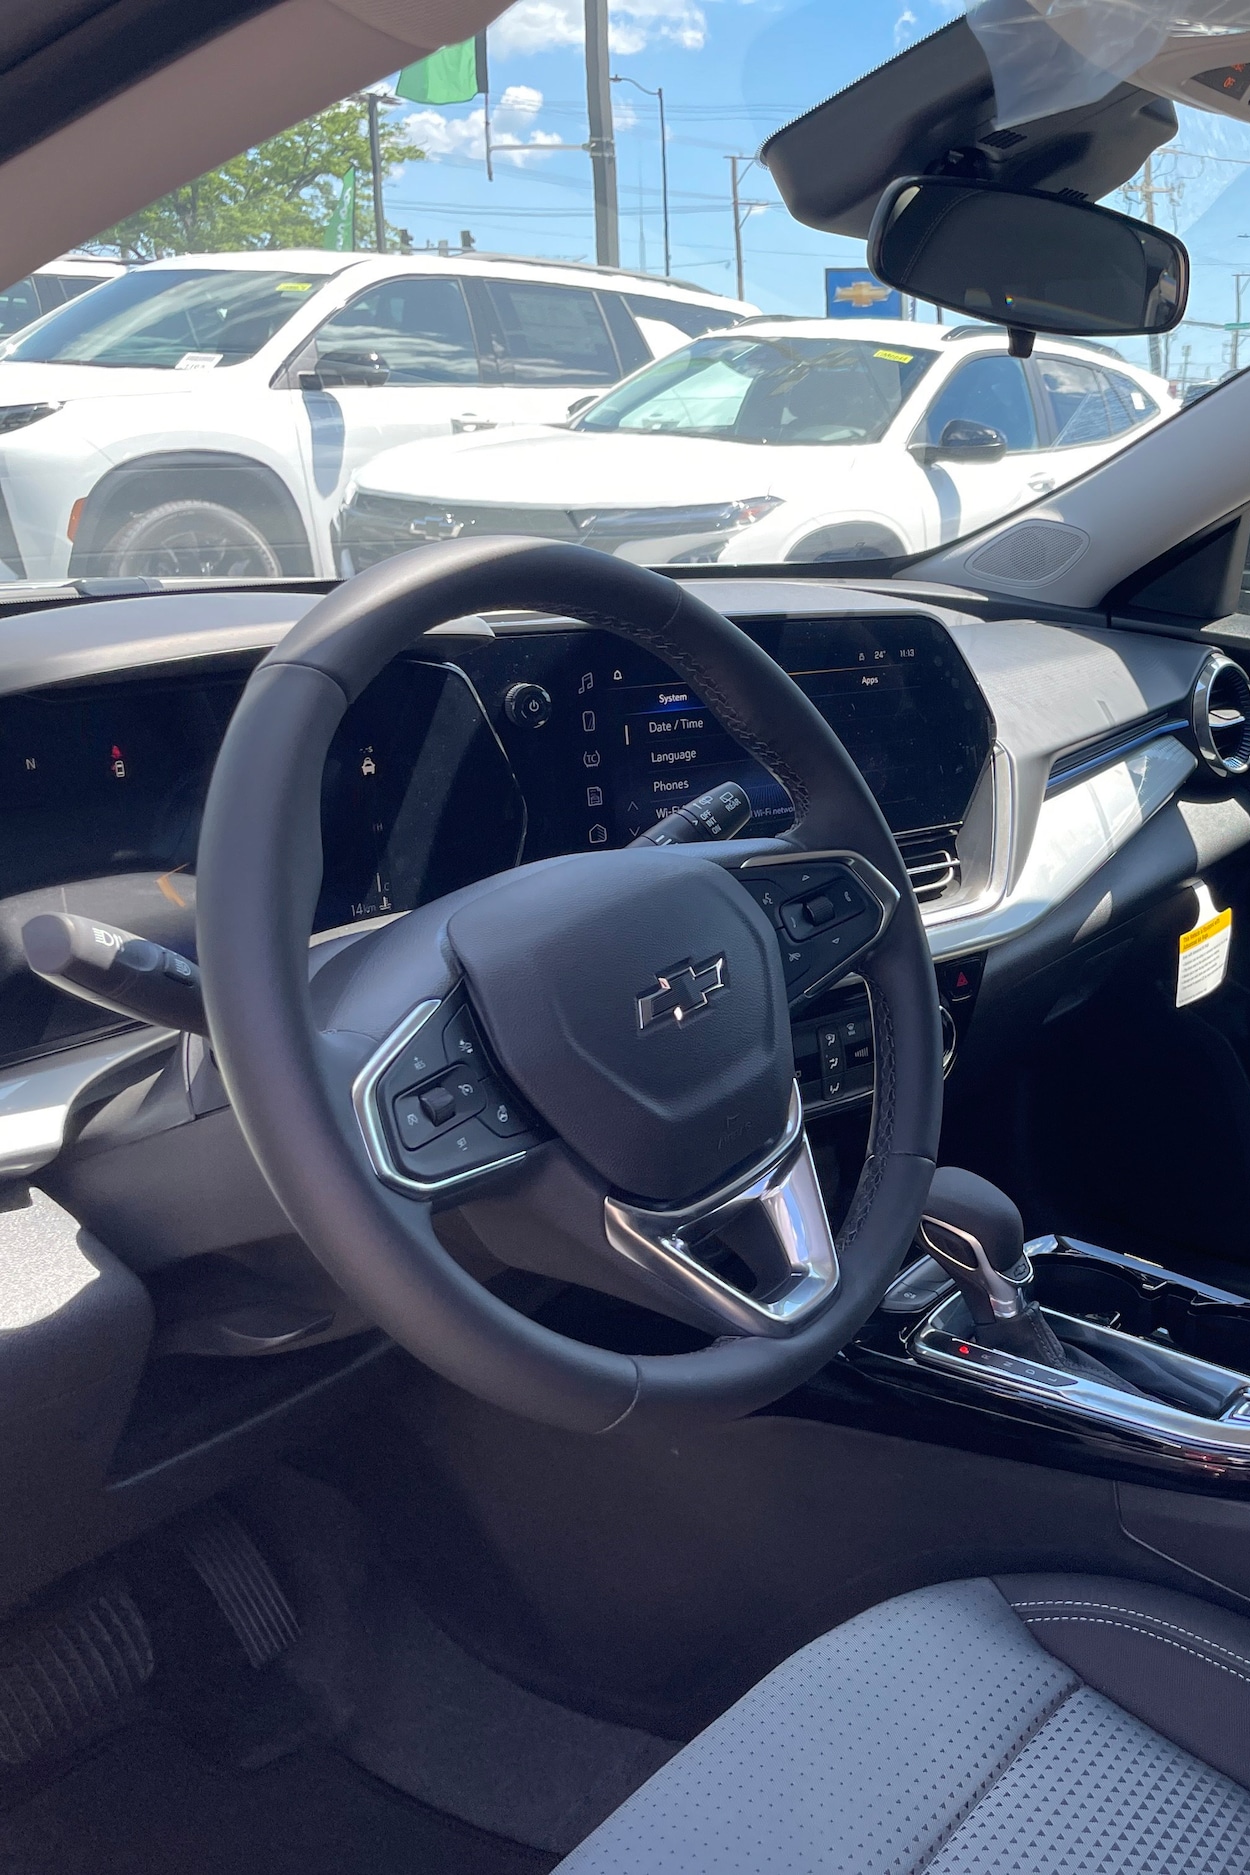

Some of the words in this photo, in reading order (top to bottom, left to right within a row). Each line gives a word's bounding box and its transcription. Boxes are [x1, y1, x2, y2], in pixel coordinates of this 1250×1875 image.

[861, 676, 879, 686] Apps
[658, 693, 688, 705] System
[648, 721, 672, 733] Date
[680, 718, 704, 730] Time
[650, 749, 697, 764] Language
[653, 780, 689, 792] Phones
[725, 797, 742, 812] REAR
[772, 806, 794, 815] netwo
